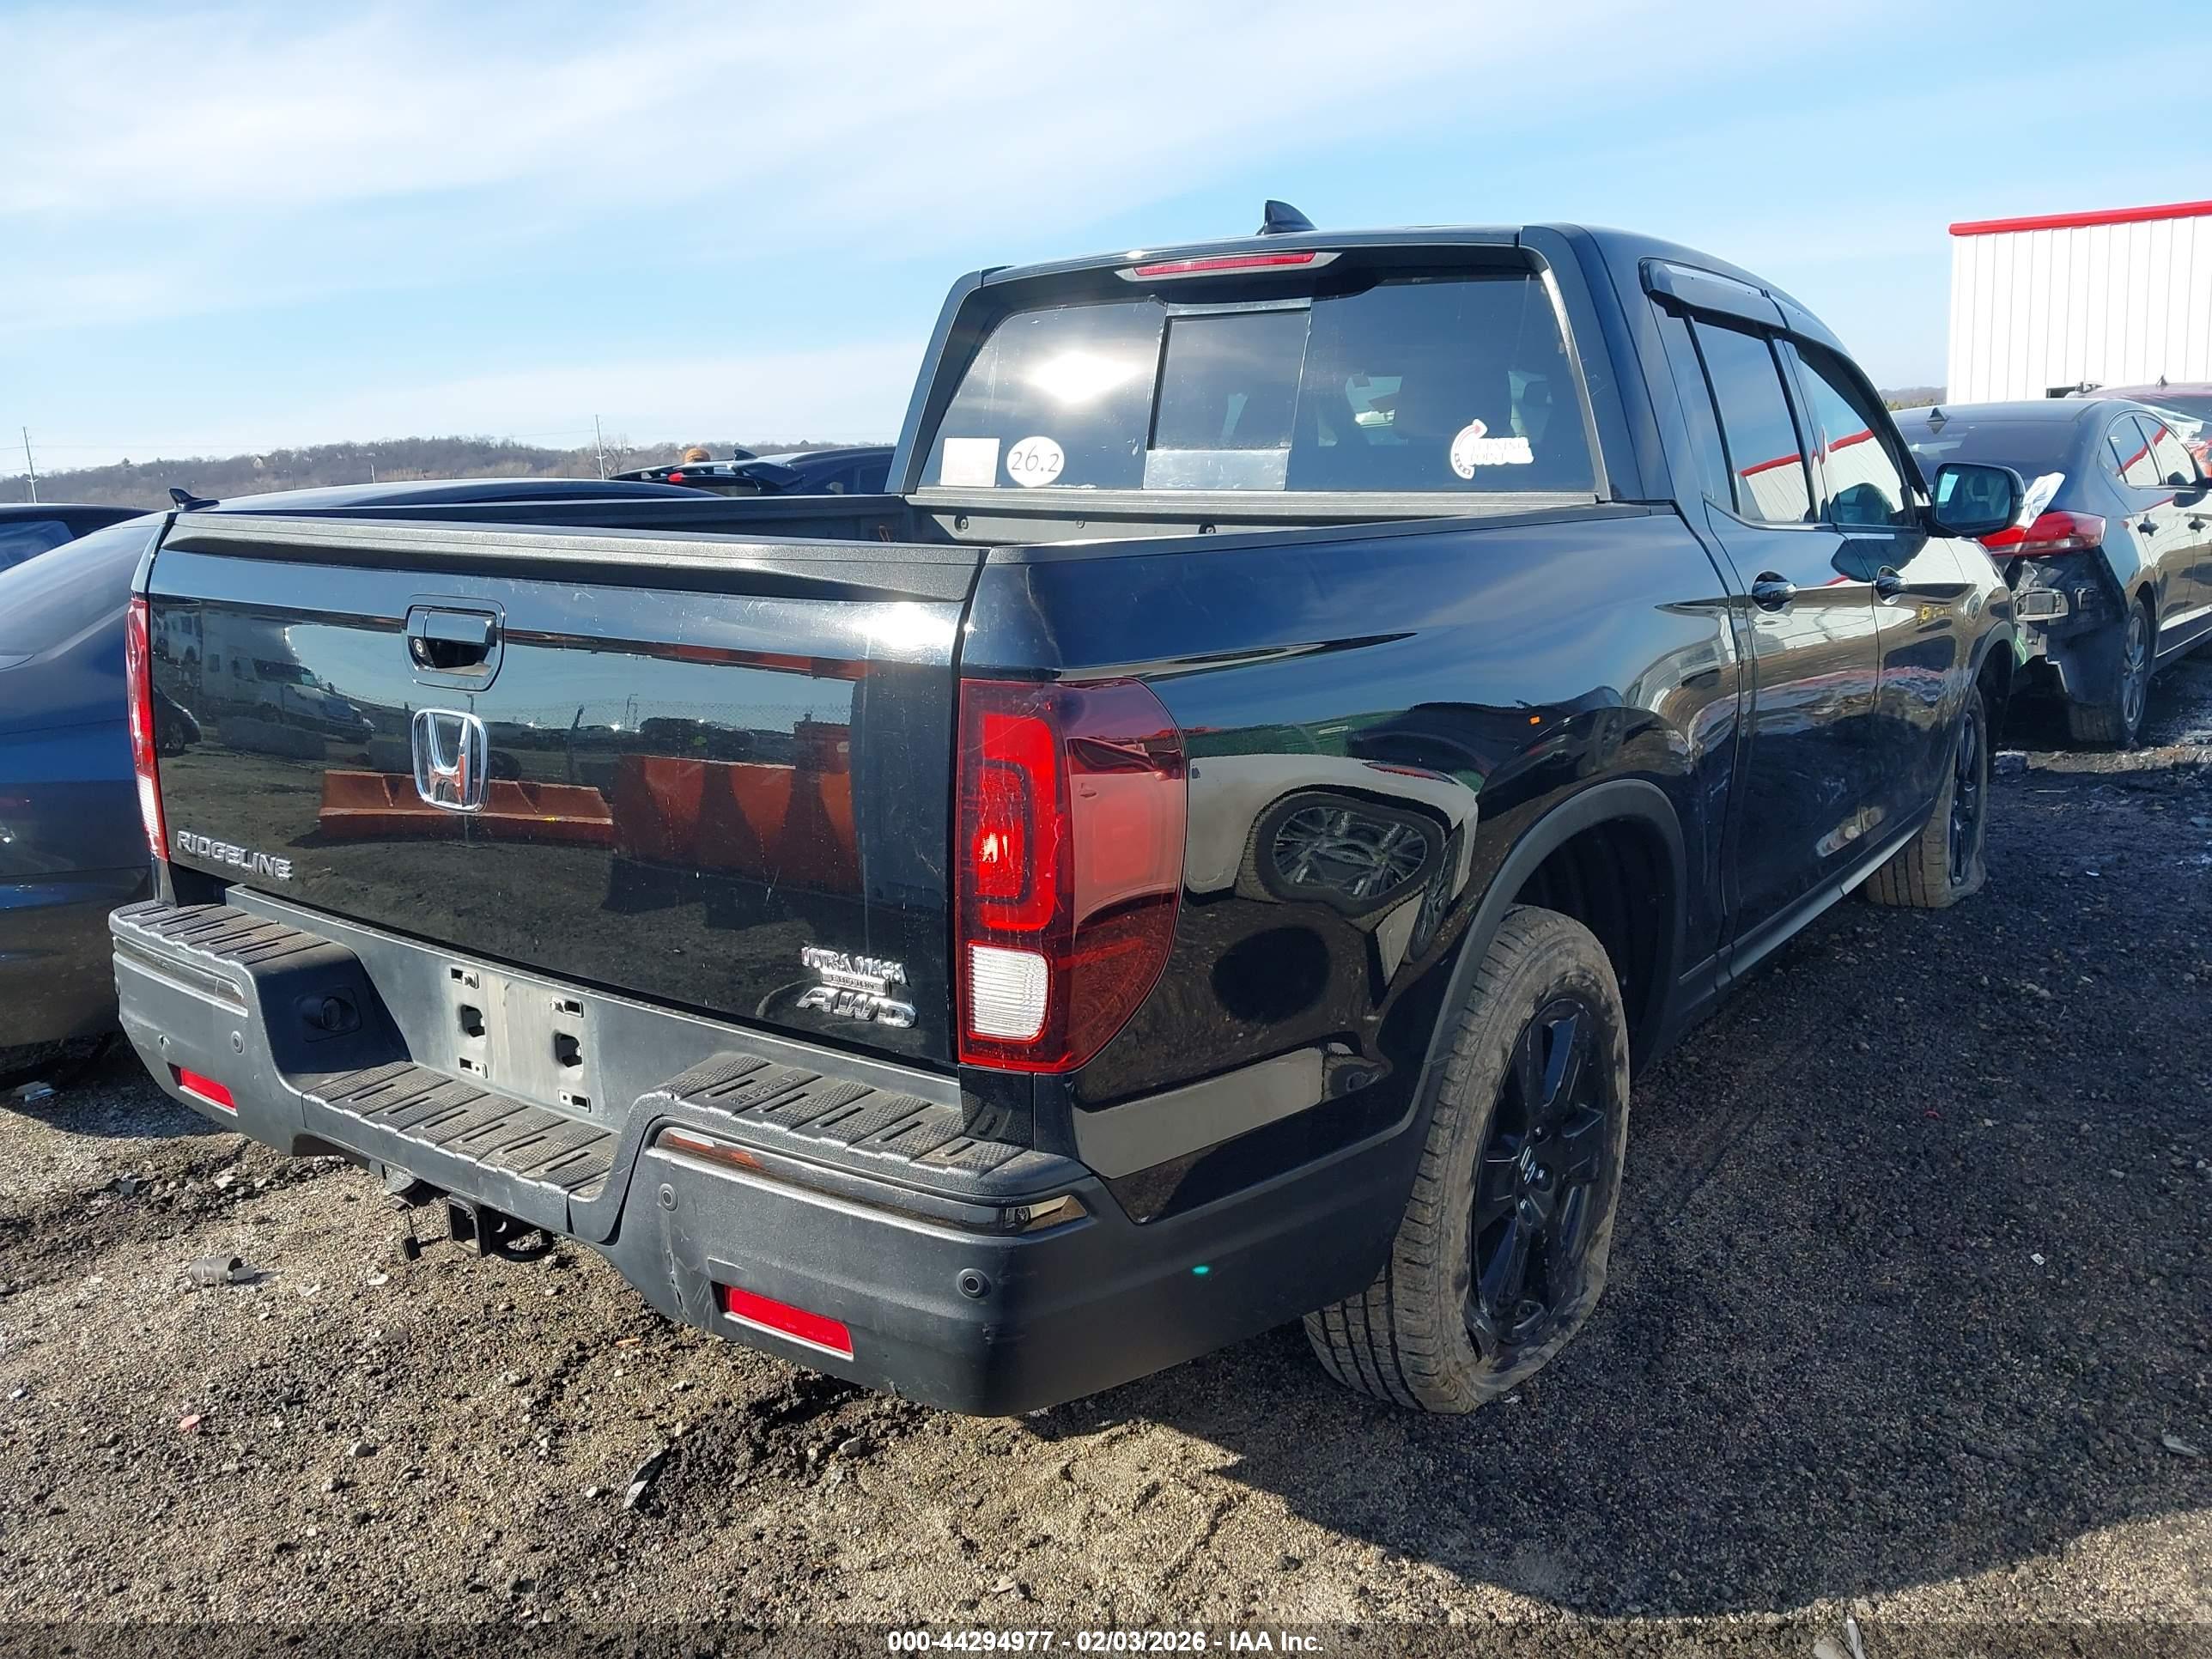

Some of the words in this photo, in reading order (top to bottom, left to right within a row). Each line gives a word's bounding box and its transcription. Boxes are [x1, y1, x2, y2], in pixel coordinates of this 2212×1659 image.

[1011, 444, 1060, 473] 26.2
[177, 830, 295, 881] RIDGELINE
[795, 987, 918, 1029] AWD
